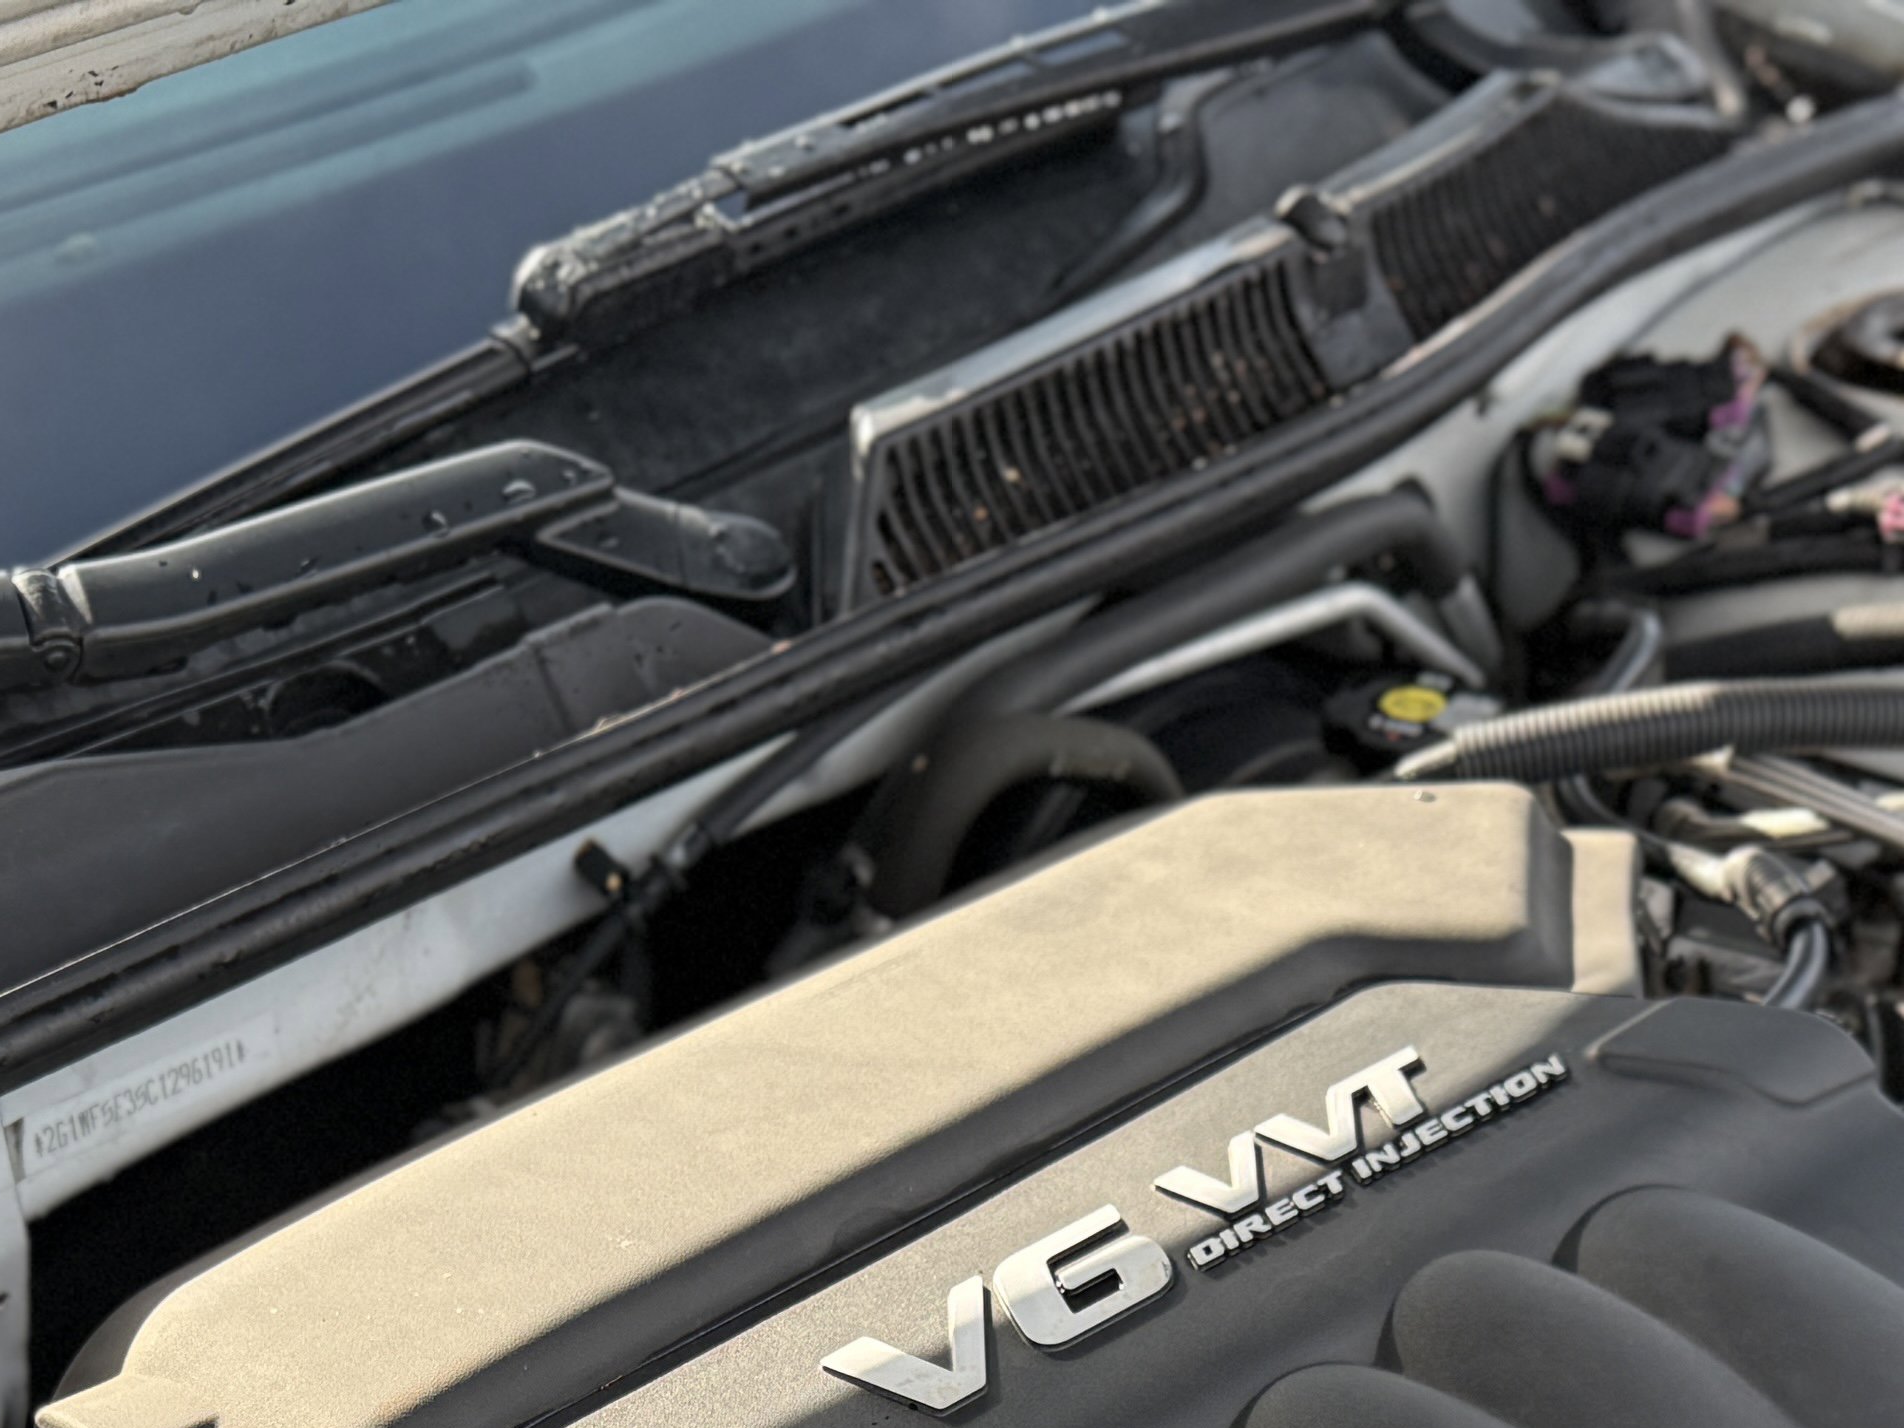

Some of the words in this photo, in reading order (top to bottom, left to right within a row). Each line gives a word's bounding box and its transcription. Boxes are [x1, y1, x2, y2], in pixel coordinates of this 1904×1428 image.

[819, 1203, 1175, 1412] V6
[1150, 1044, 1428, 1216] VVT
[1188, 1168, 1347, 1271] DIRECT
[1351, 1054, 1570, 1185] INJECTION
